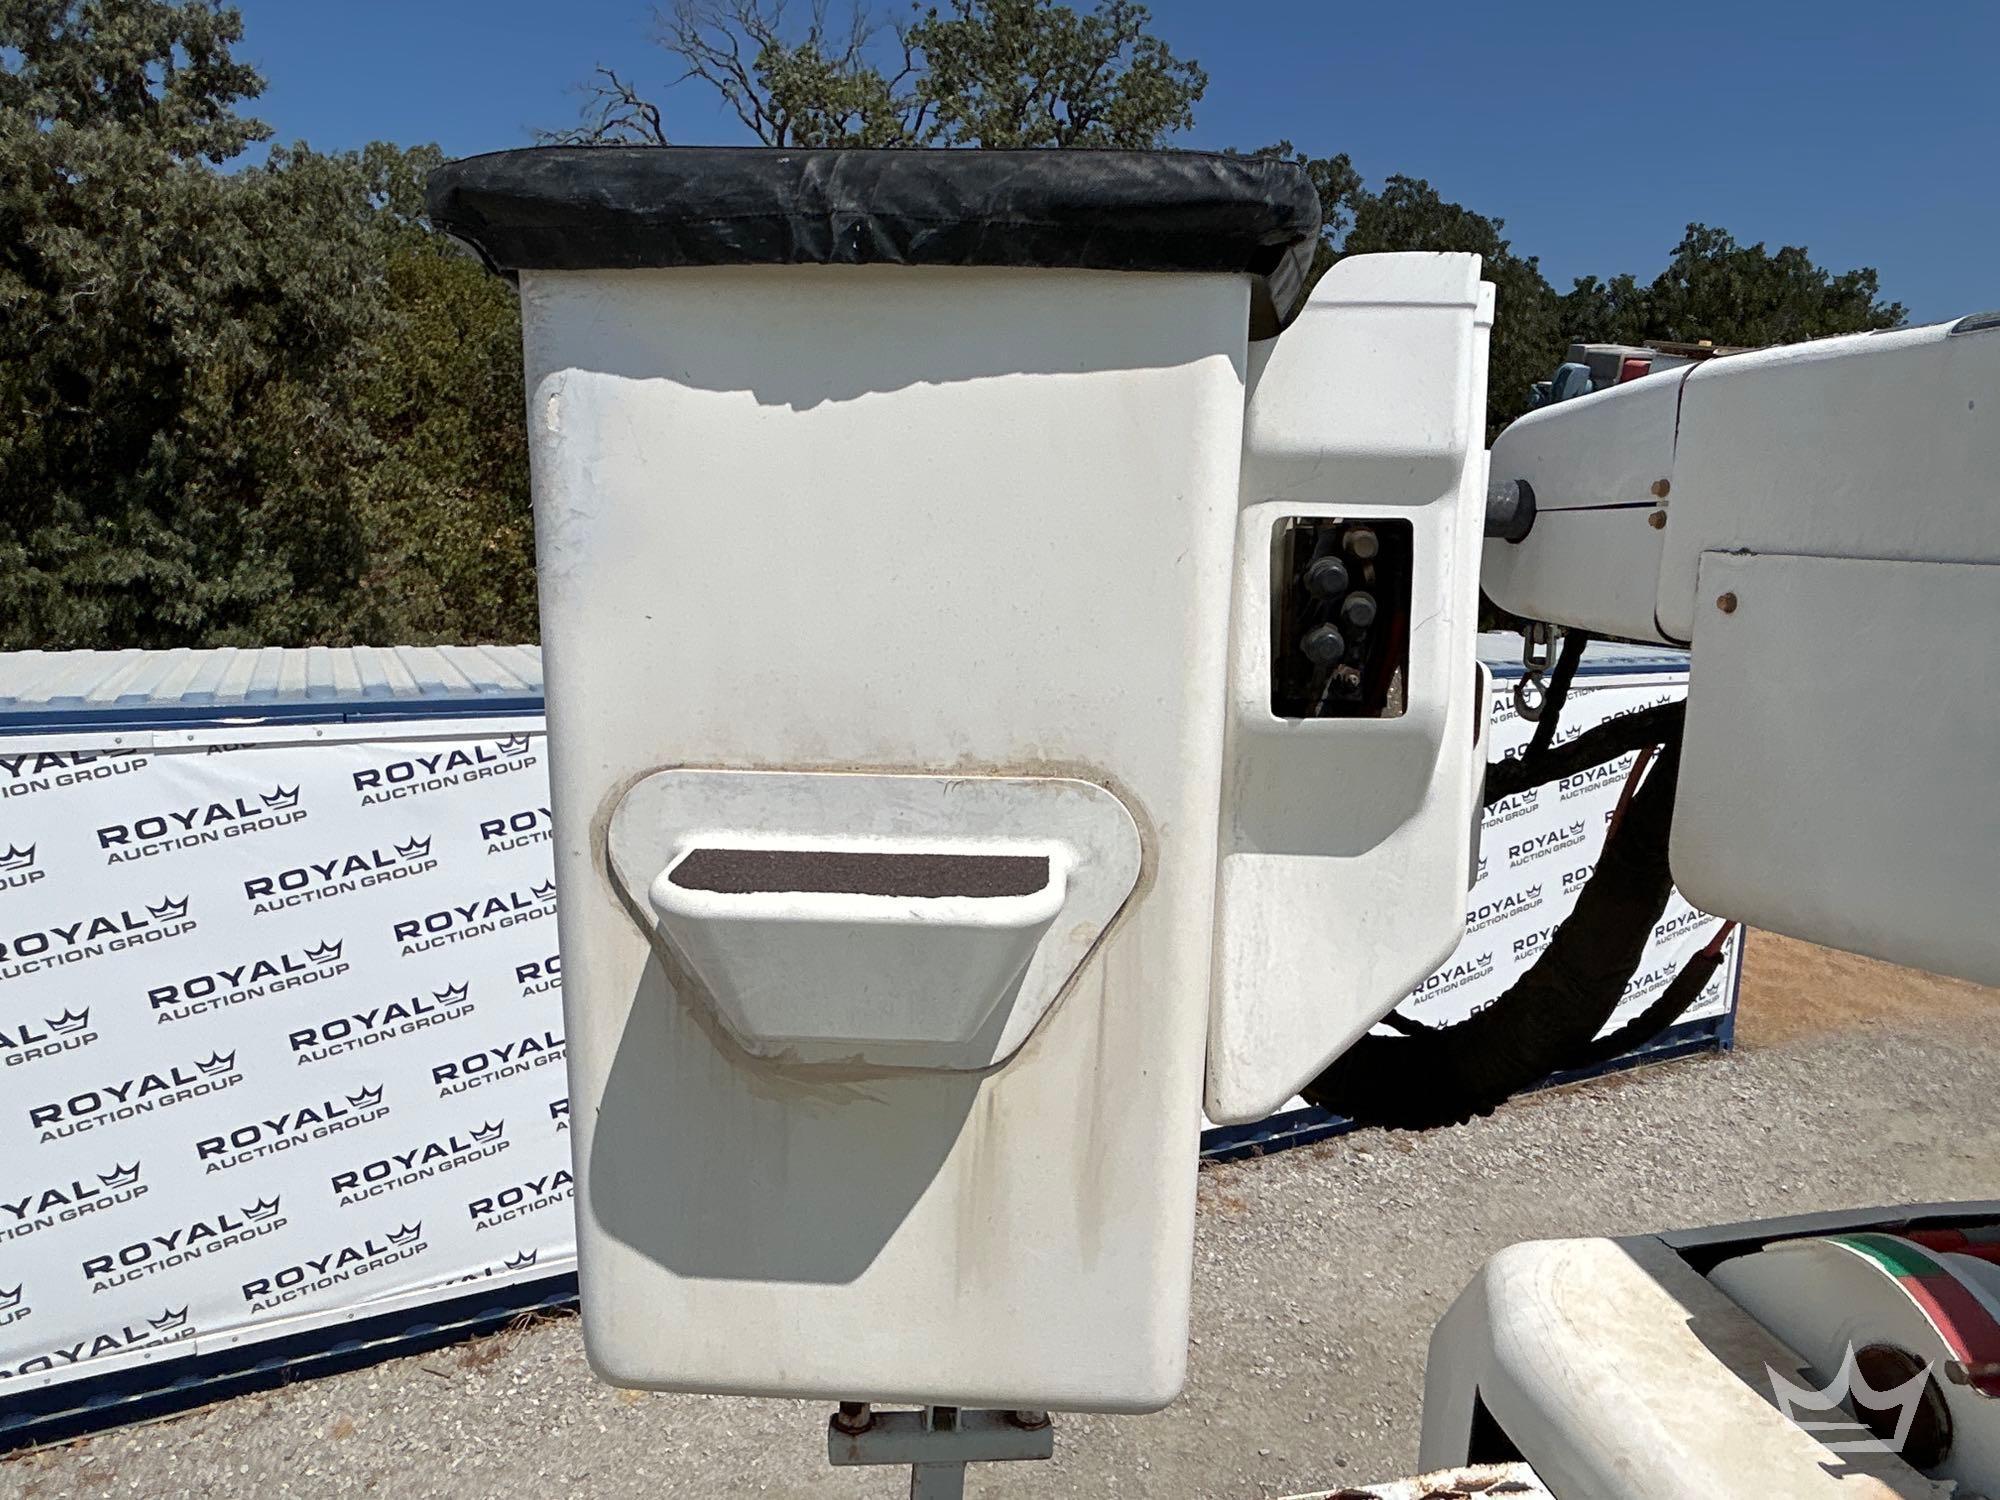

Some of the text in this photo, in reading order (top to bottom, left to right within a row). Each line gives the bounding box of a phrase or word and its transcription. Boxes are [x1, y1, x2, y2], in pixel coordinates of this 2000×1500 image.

[0, 750, 98, 778] YAL
[56, 758, 148, 787] GROUP
[352, 745, 497, 791] ROYAL
[361, 757, 537, 806] AUCTION GROUP
[1559, 763, 1618, 792] ROYAL
[1560, 772, 1630, 801] AUCTION GROU
[97, 798, 262, 849] ROYAL
[1481, 803, 1539, 830] TION GROUP
[1482, 796, 1522, 820] YAL
[107, 809, 308, 865] AUCTION GROUP
[487, 829, 553, 855] AUCTI
[1508, 828, 1570, 859] ROYAL
[1510, 835, 1587, 869] AUCTION GROUP
[244, 849, 396, 900] ROYAL
[253, 859, 438, 916] AUCTION GROUP
[394, 892, 532, 942] ROYAL
[401, 904, 557, 957] AUCTION GROU
[1465, 892, 1527, 926] ROYAL
[1465, 898, 1543, 935] AUCTION GROUP
[0, 921, 198, 980] UCTION GROUP
[1656, 926, 1691, 946] AUCTION
[147, 954, 306, 1009] ROYAL
[157, 963, 350, 1025] AUCTION GROUP
[1413, 966, 1494, 1006] AUCTION GROUP
[288, 997, 435, 1051] ROYAL
[297, 1004, 475, 1066] AUCTION GROUP
[5, 1032, 99, 1067] GROUP
[432, 1031, 566, 1085] ROYAL
[29, 1067, 197, 1128] ROYAL
[439, 1061, 530, 1099] AUCTION
[40, 1074, 244, 1144] AUCTION GROUP
[196, 1101, 348, 1160] ROYAL
[205, 1107, 390, 1175] AUCTION GROUP
[331, 1136, 471, 1194] ROYAL
[339, 1141, 510, 1208] AUCTION GROUP
[469, 1169, 573, 1219] ROYA
[0, 1181, 100, 1220] YAL
[59, 1185, 149, 1223] GROUP
[475, 1192, 563, 1232] AUCTION
[82, 1214, 243, 1280] ROYAL
[92, 1218, 288, 1294] AUCTION GROUP
[242, 1239, 388, 1301] ROYAL
[251, 1242, 428, 1314] AUCTION GROUP
